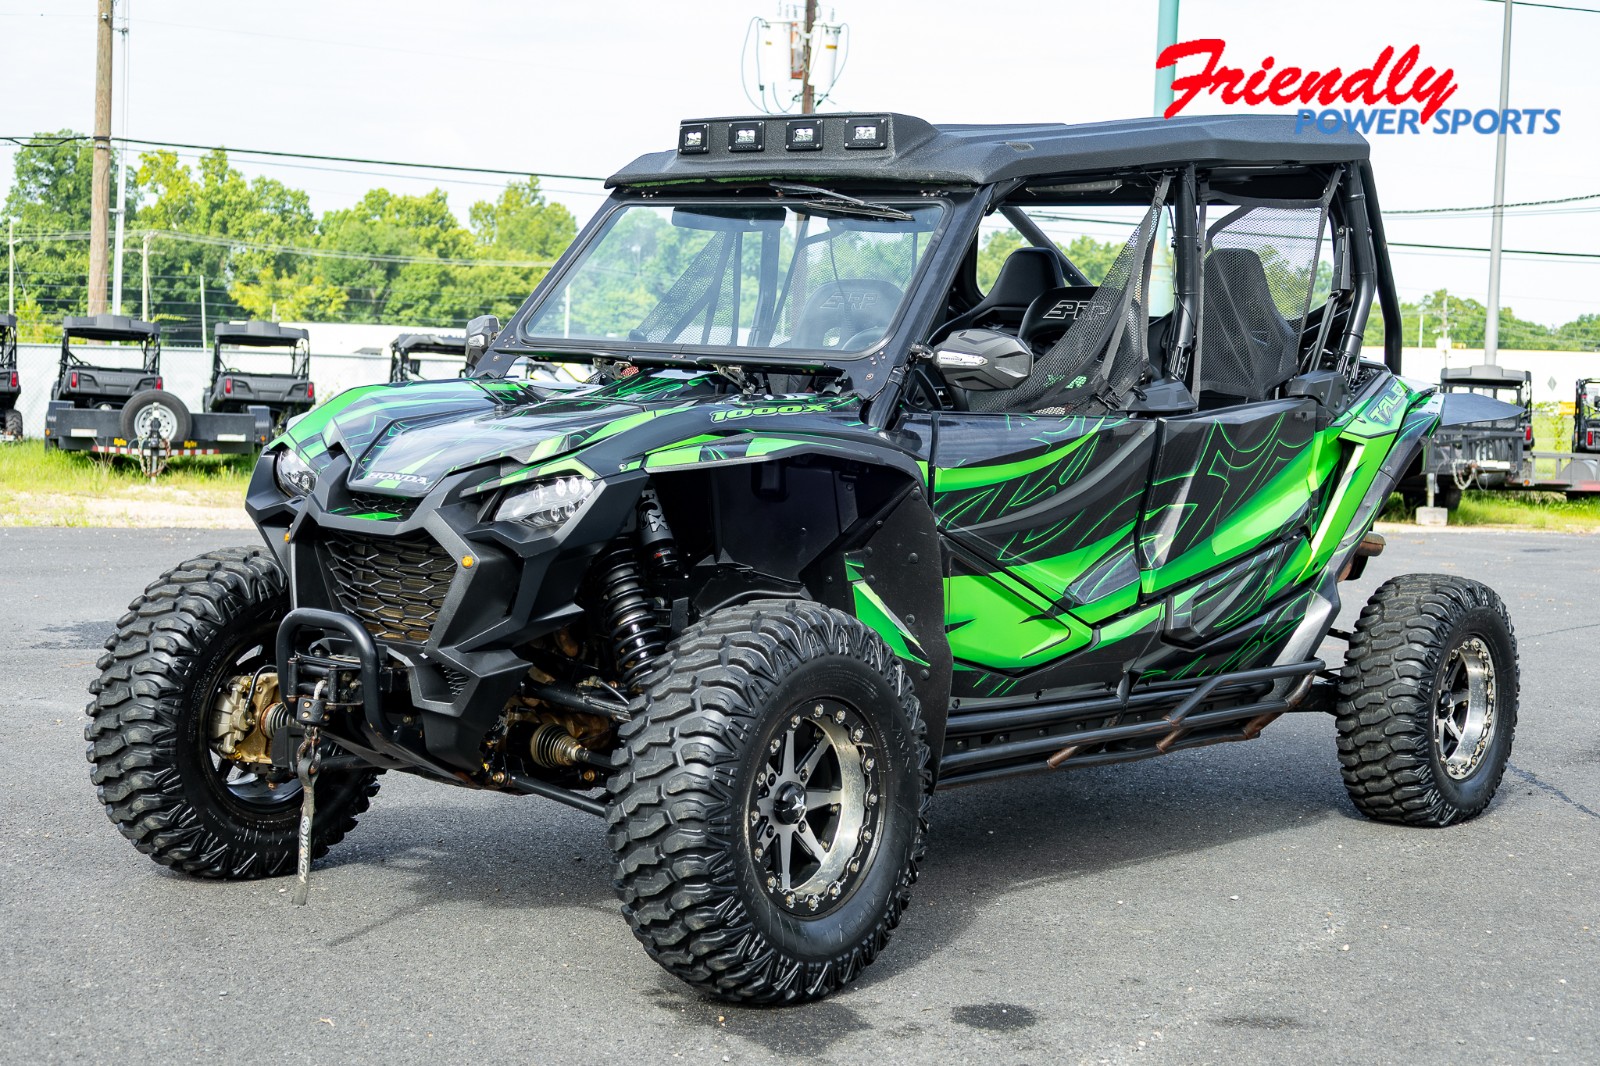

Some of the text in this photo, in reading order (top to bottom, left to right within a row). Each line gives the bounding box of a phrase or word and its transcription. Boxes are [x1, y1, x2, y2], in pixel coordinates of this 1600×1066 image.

[709, 403, 832, 424] 1000X
[367, 471, 430, 486] HONDA
[640, 488, 669, 533] FOX
